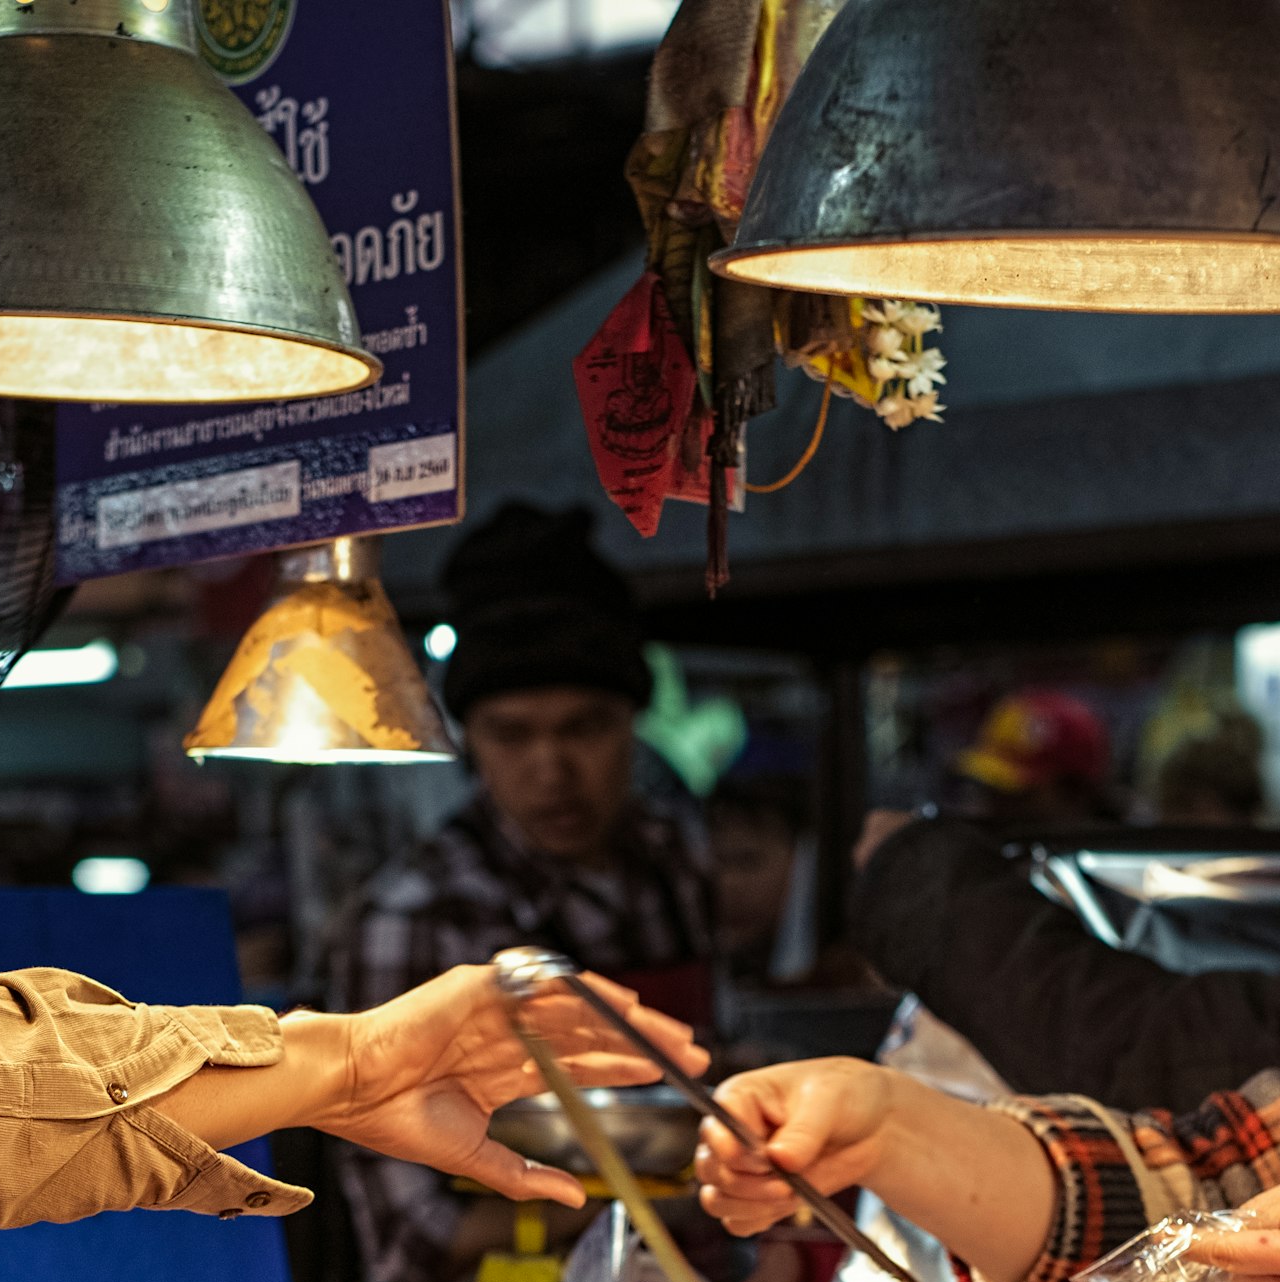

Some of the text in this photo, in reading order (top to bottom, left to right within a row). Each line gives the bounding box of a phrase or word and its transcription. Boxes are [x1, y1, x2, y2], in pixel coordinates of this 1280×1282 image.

[331, 190, 444, 285] อดภัย
[362, 305, 427, 354] ทอดซ้ำ
